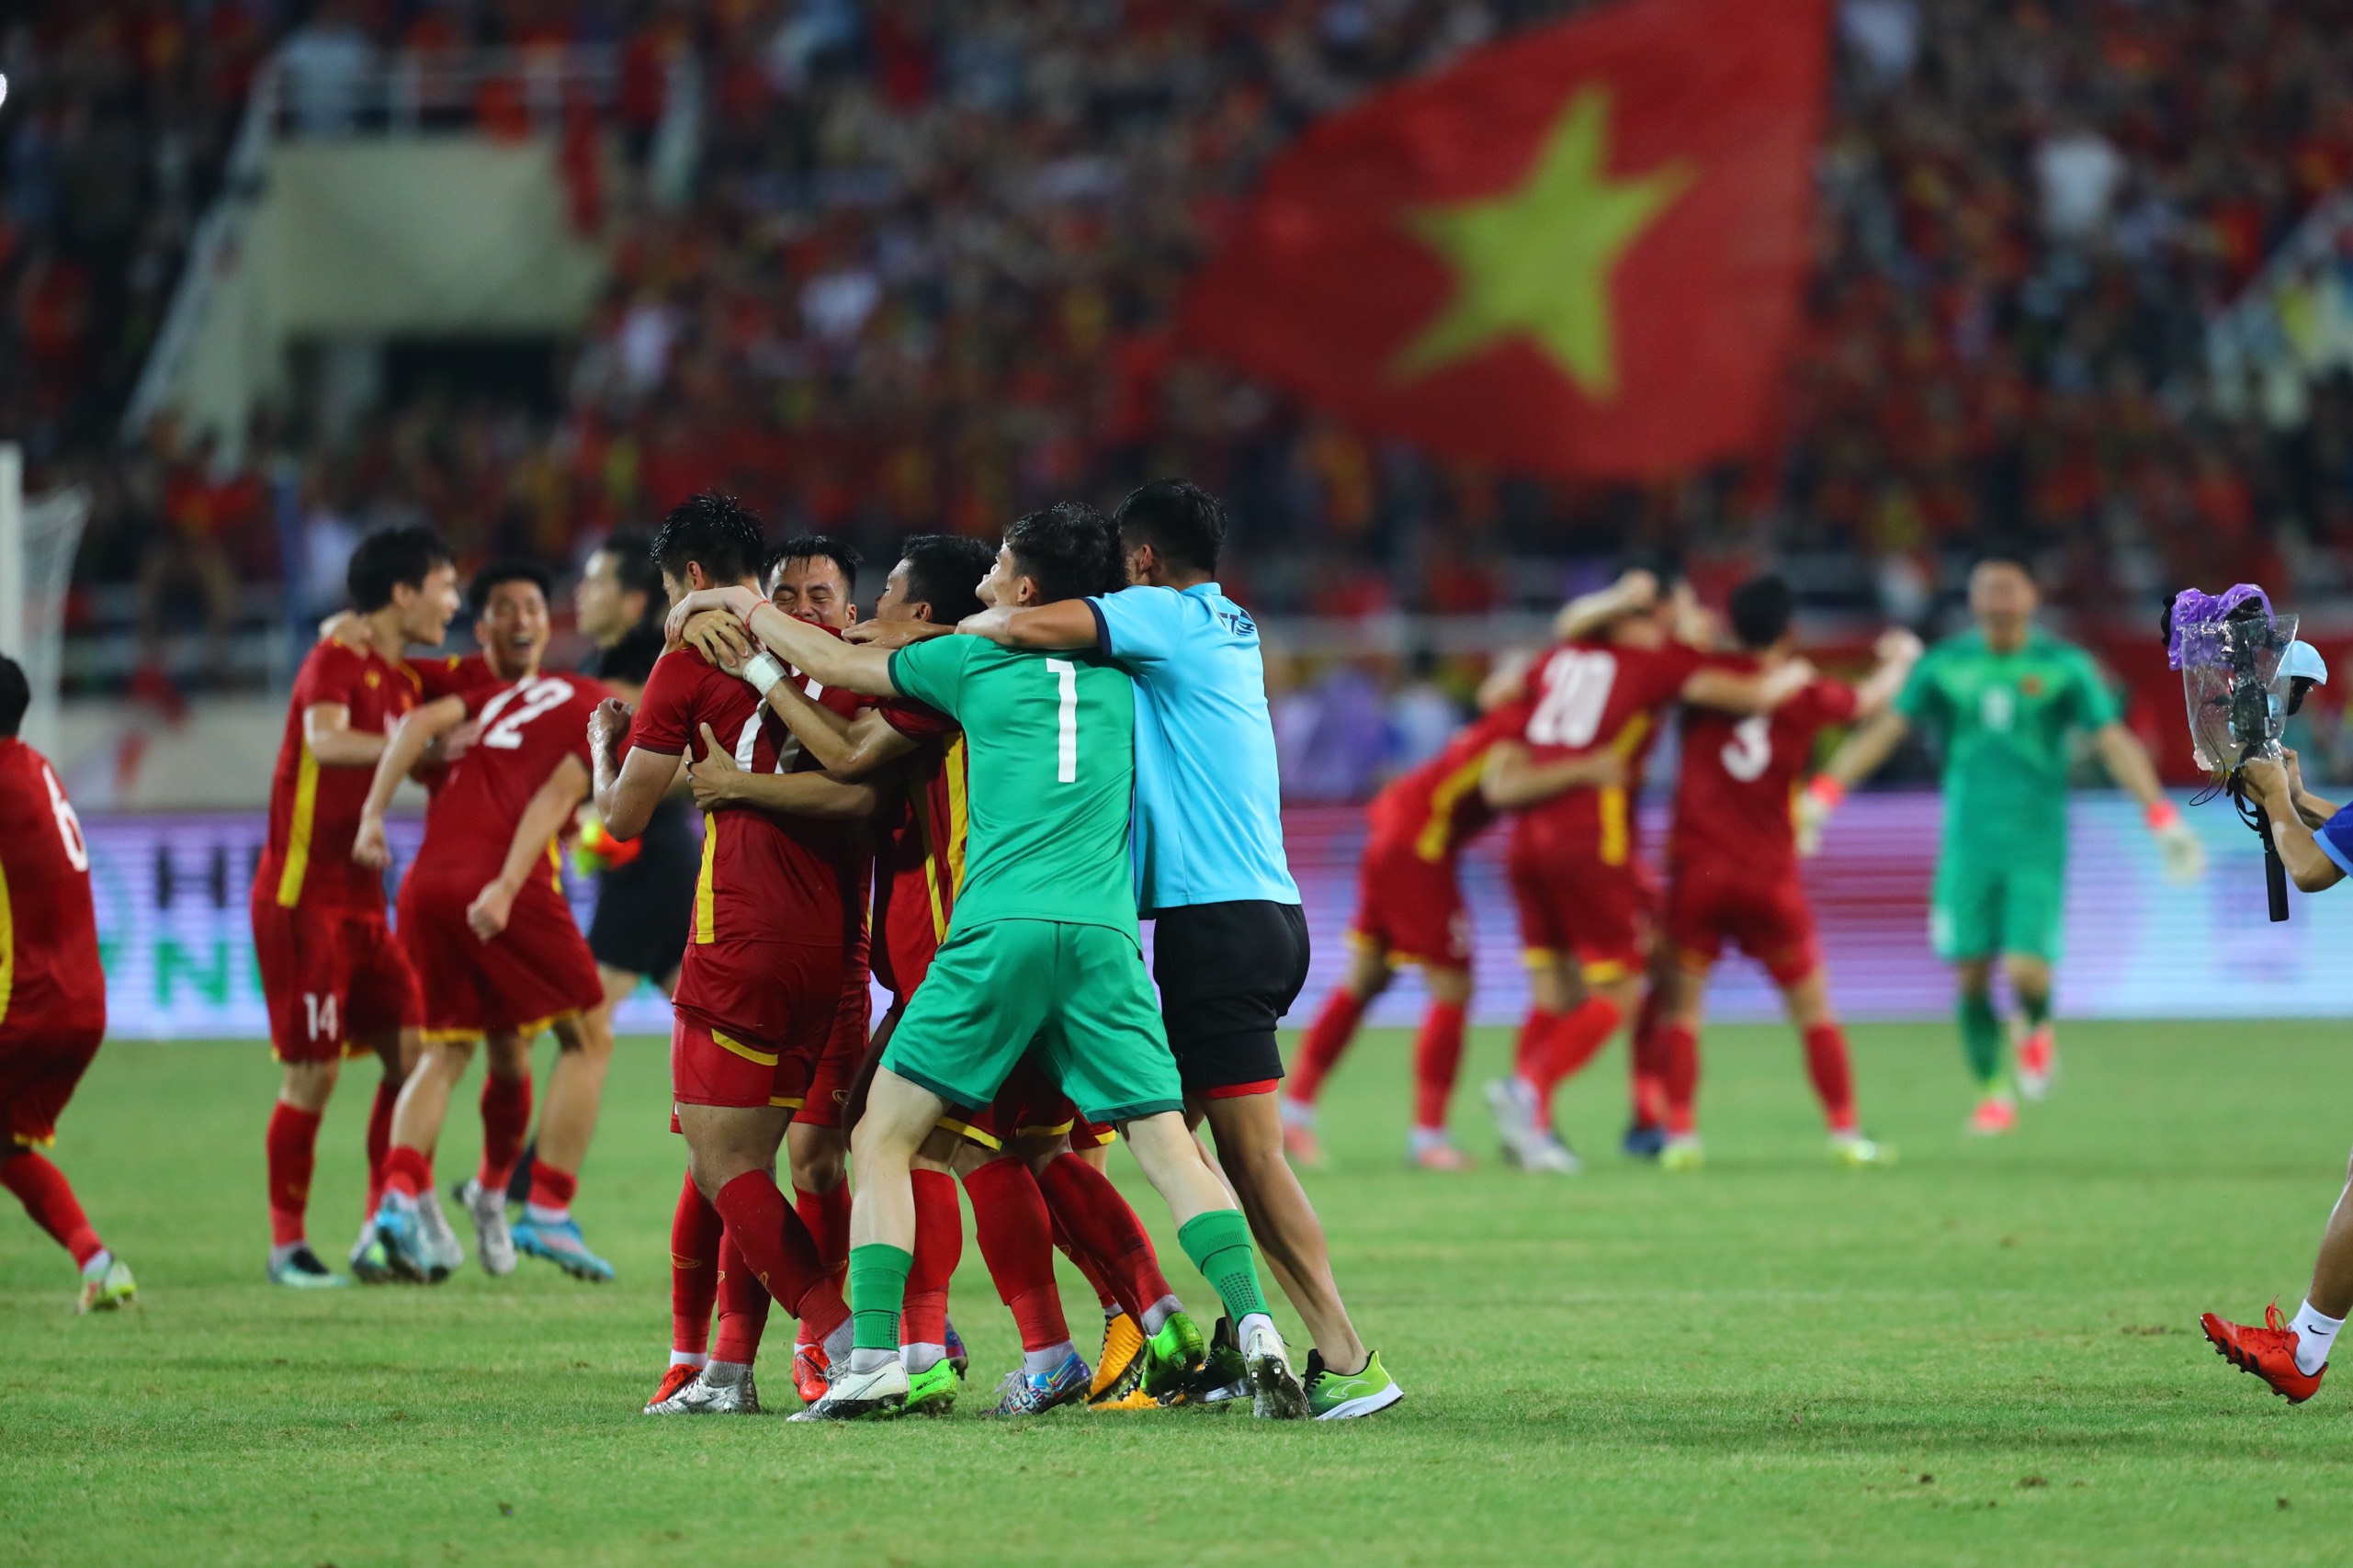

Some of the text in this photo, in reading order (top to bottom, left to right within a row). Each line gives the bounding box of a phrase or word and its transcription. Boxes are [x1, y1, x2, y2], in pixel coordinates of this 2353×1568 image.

[479, 676, 575, 750] 12
[1046, 658, 1077, 783] 1
[1720, 716, 1770, 782] 3
[43, 763, 88, 872] 6
[303, 992, 338, 1041] 14
